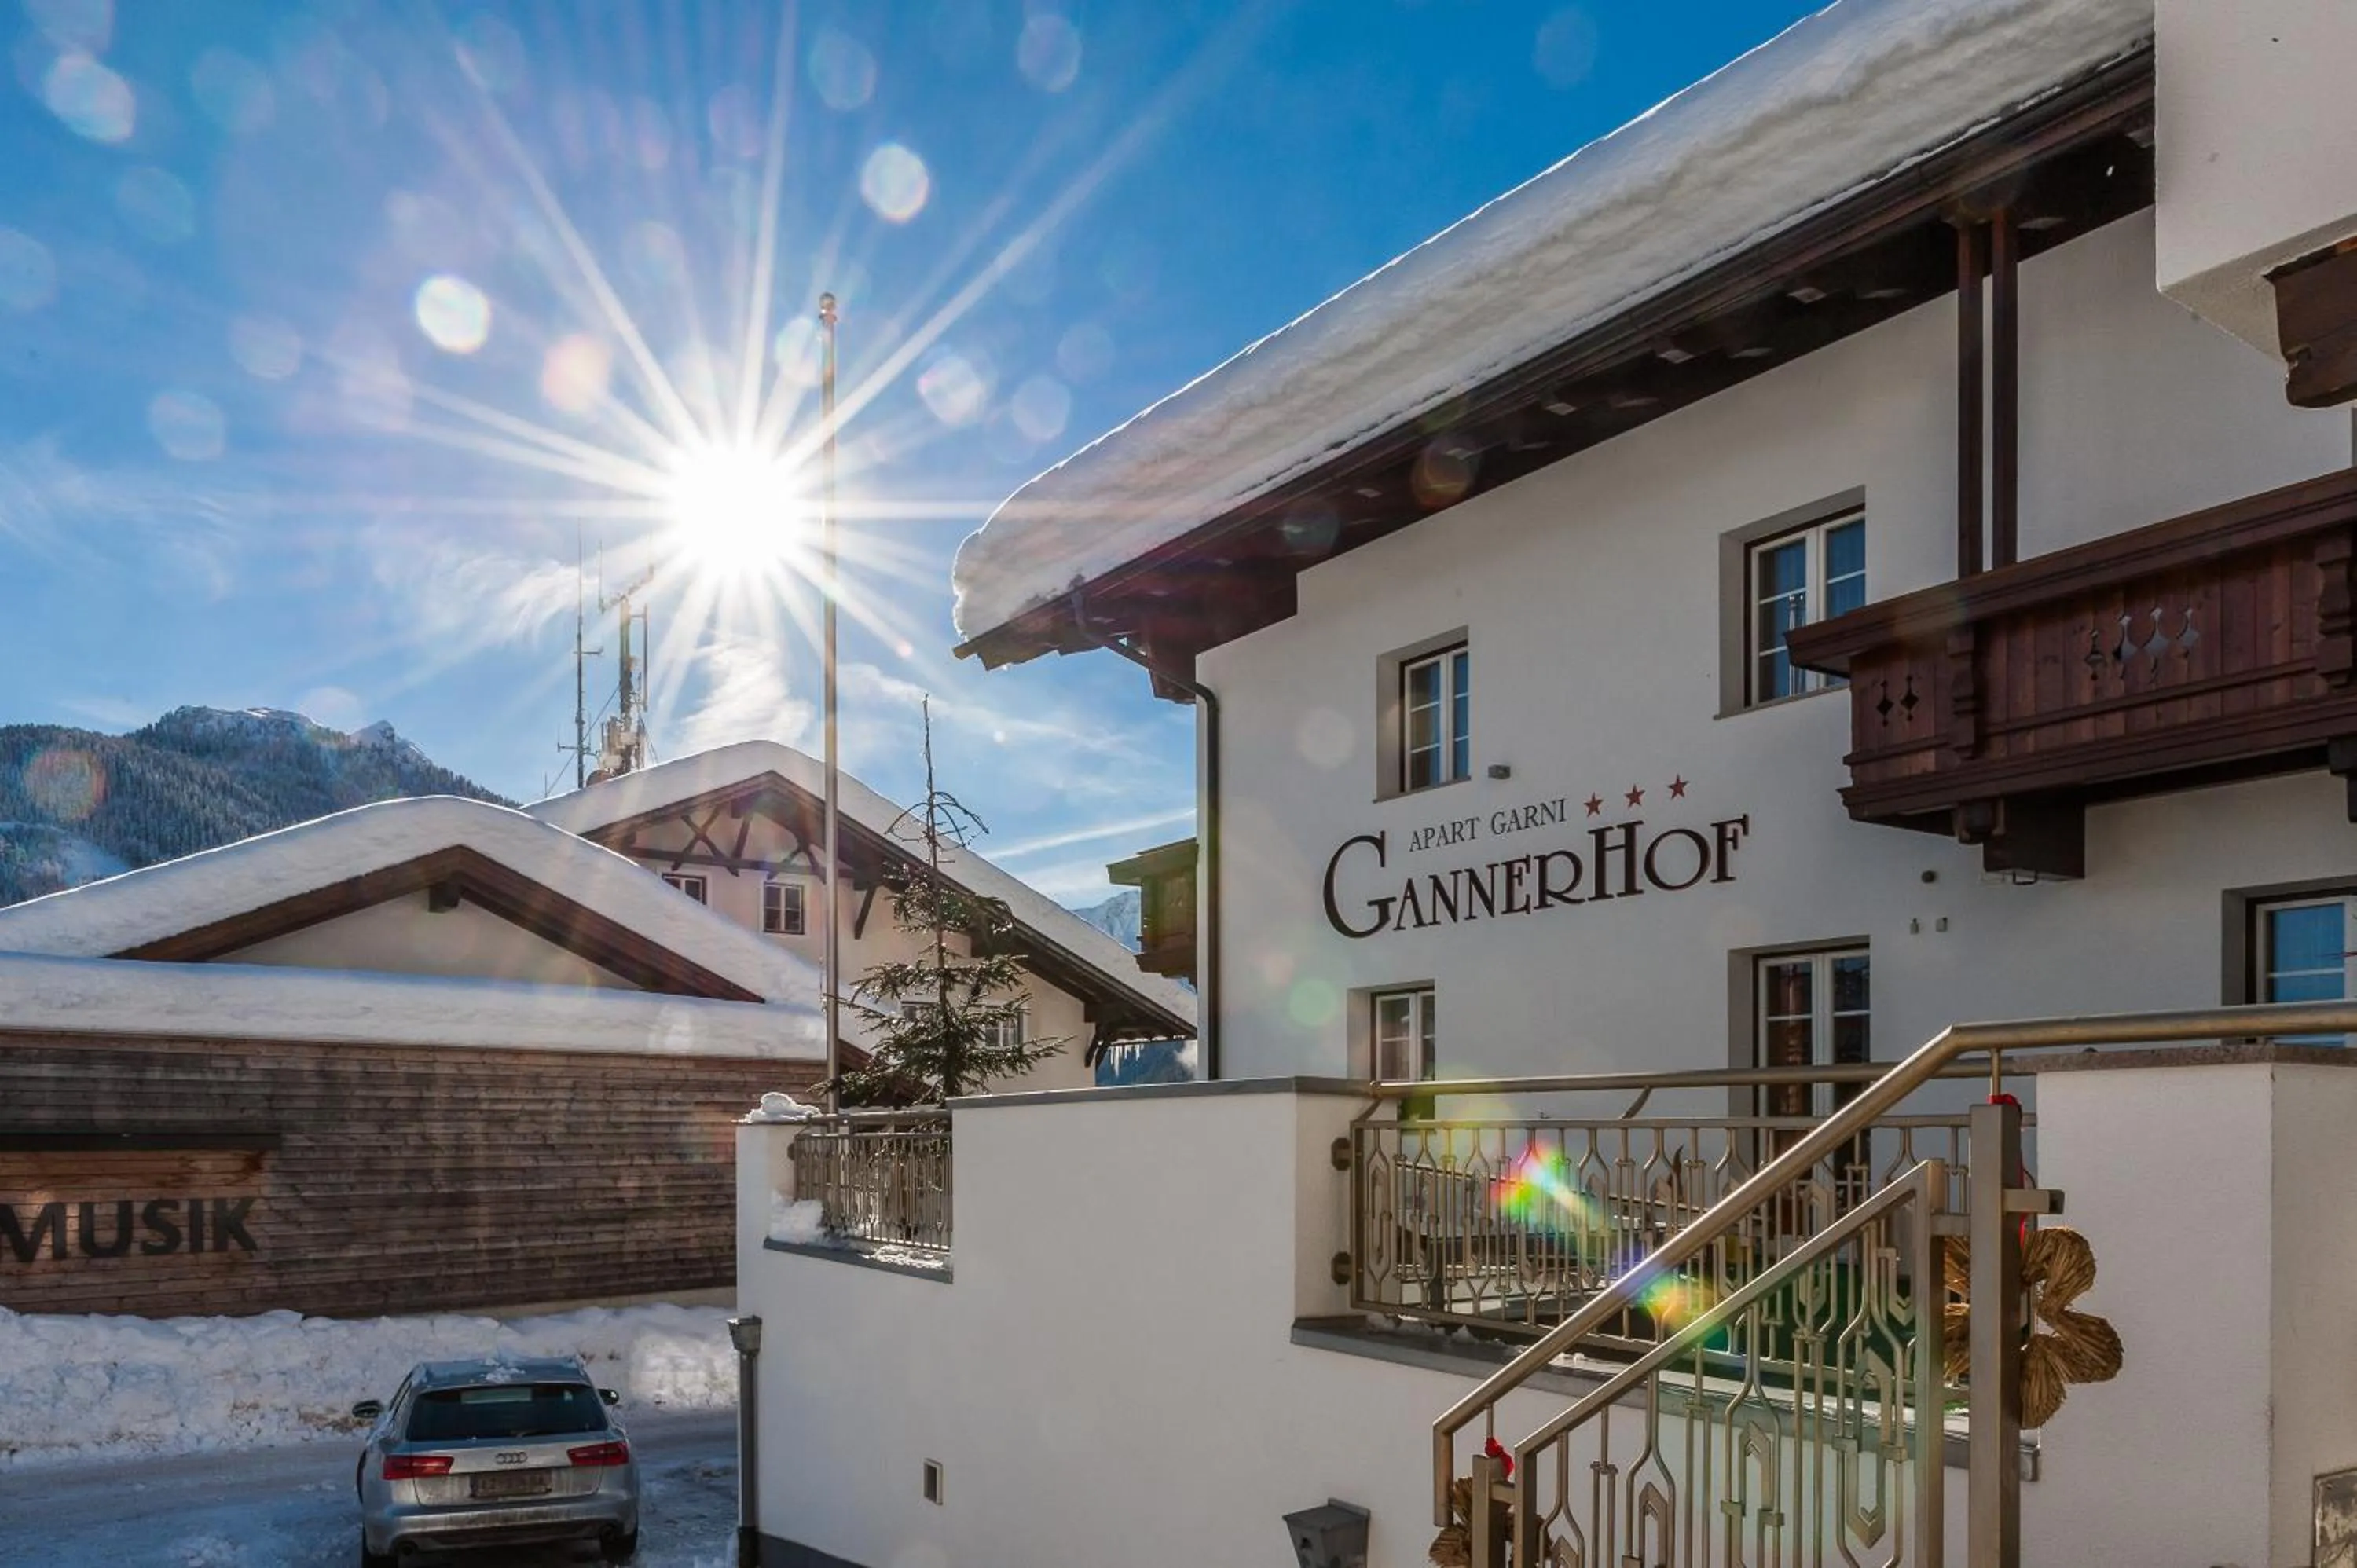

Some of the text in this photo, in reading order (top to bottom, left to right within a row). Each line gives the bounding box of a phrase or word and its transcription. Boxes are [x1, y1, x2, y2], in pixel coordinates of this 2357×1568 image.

[1409, 798, 1568, 852] APART GARNI
[0, 1196, 258, 1263] MUSIK
